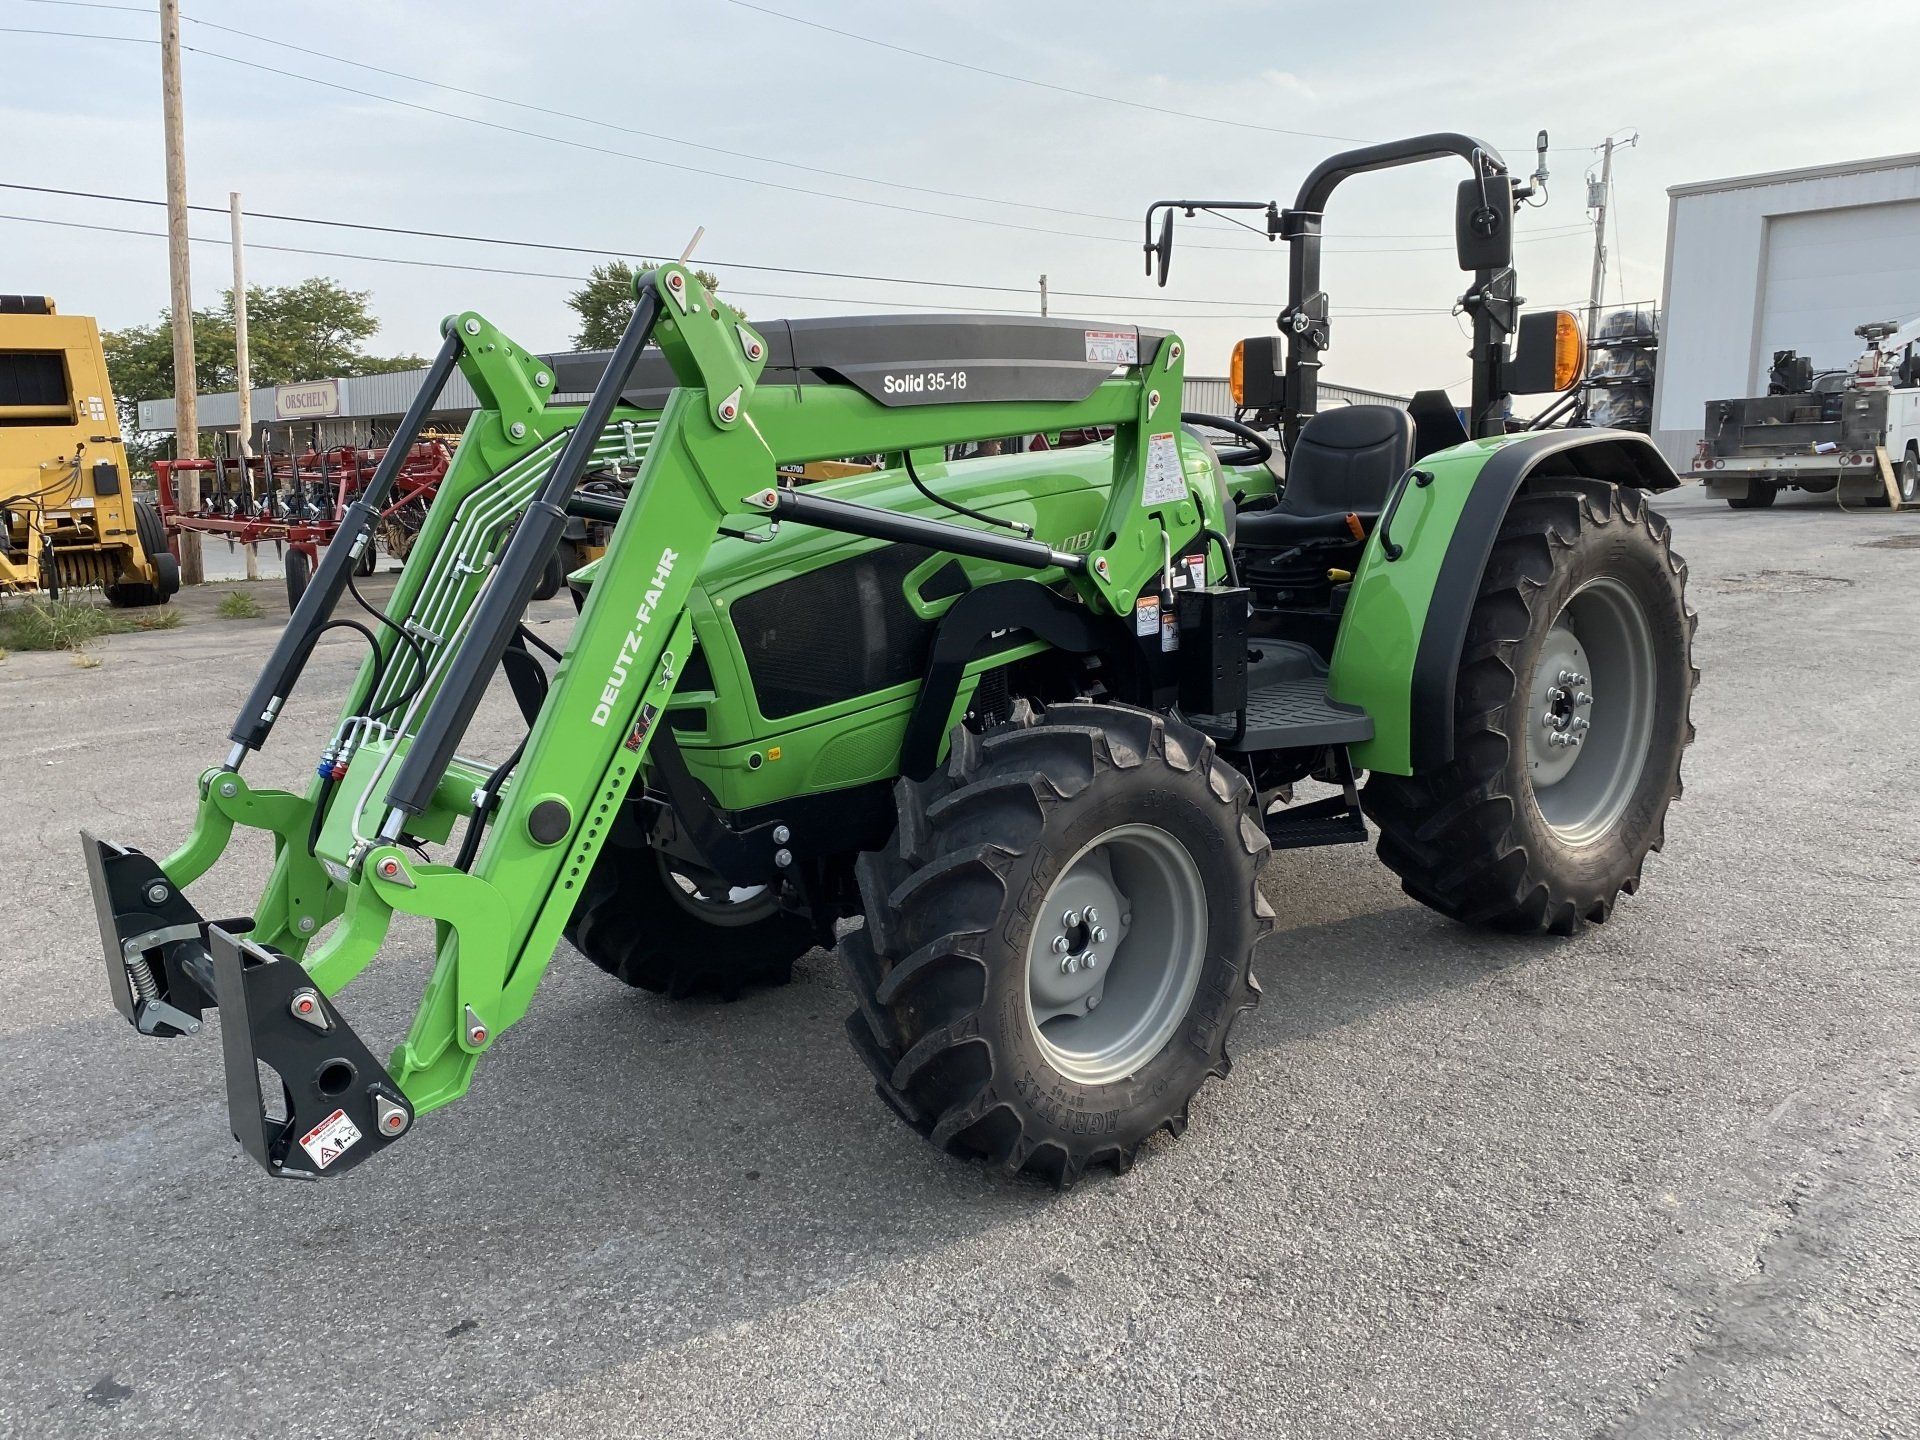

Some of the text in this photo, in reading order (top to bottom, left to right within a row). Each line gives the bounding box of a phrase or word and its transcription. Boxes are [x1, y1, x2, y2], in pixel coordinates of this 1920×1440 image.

[883, 371, 967, 394] Solid 35-18
[285, 391, 328, 410] ORSCHELN
[591, 547, 679, 727] DEUTZ-FAHR
